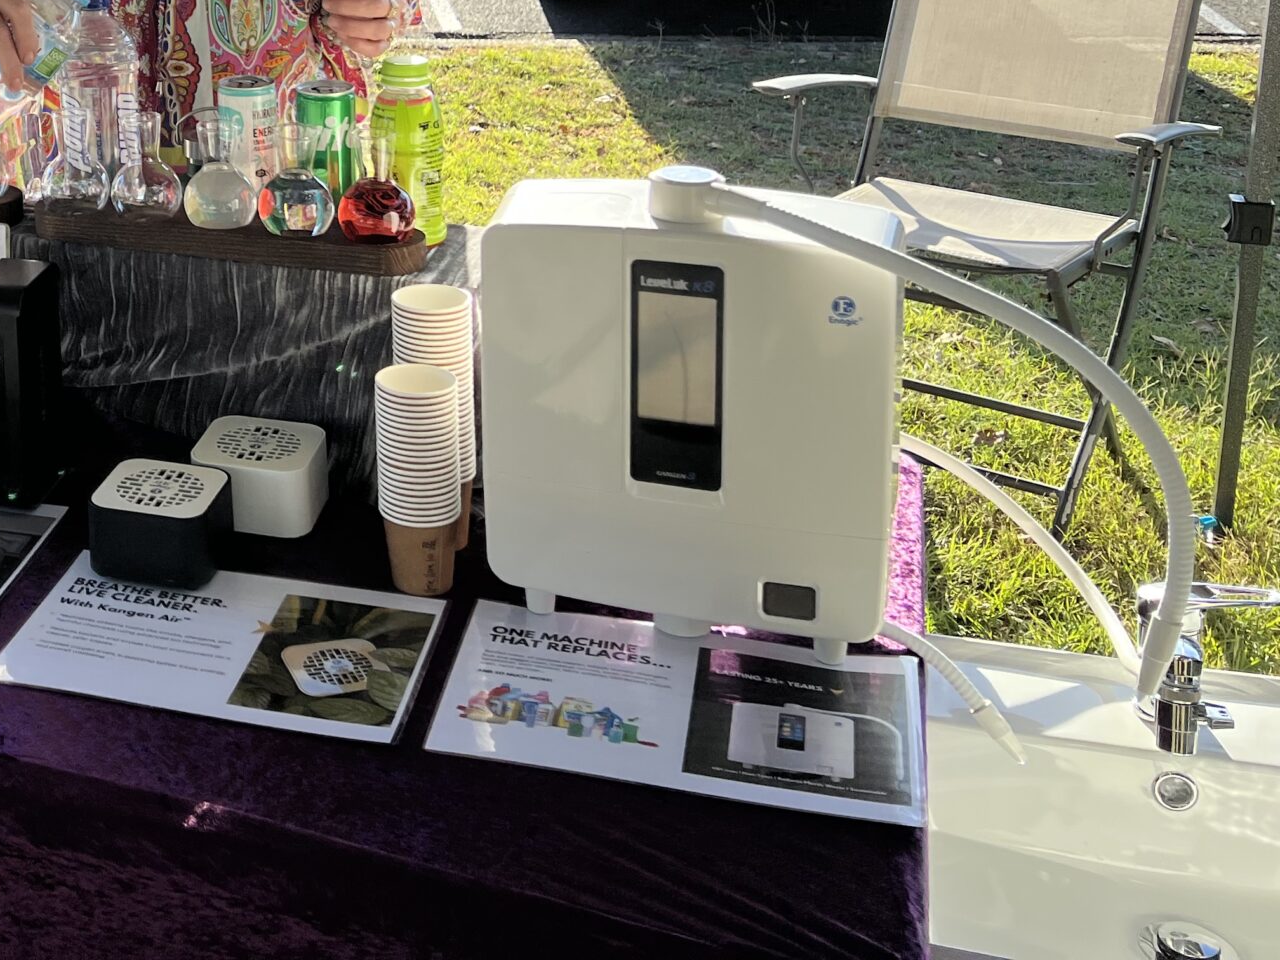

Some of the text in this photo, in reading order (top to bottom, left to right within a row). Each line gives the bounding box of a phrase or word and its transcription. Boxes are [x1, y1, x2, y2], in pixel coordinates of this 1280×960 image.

[67, 585, 200, 614] LIVE CLEANER.
[74, 577, 229, 609] BREATHE BETTER.
[59, 596, 93, 610] With
[97, 603, 155, 621] Kangen
[489, 633, 673, 670] THAT REPLACES...
[492, 626, 639, 654] ONE MACHINE
[715, 669, 762, 683] LASTING
[786, 680, 824, 693] YEARS
